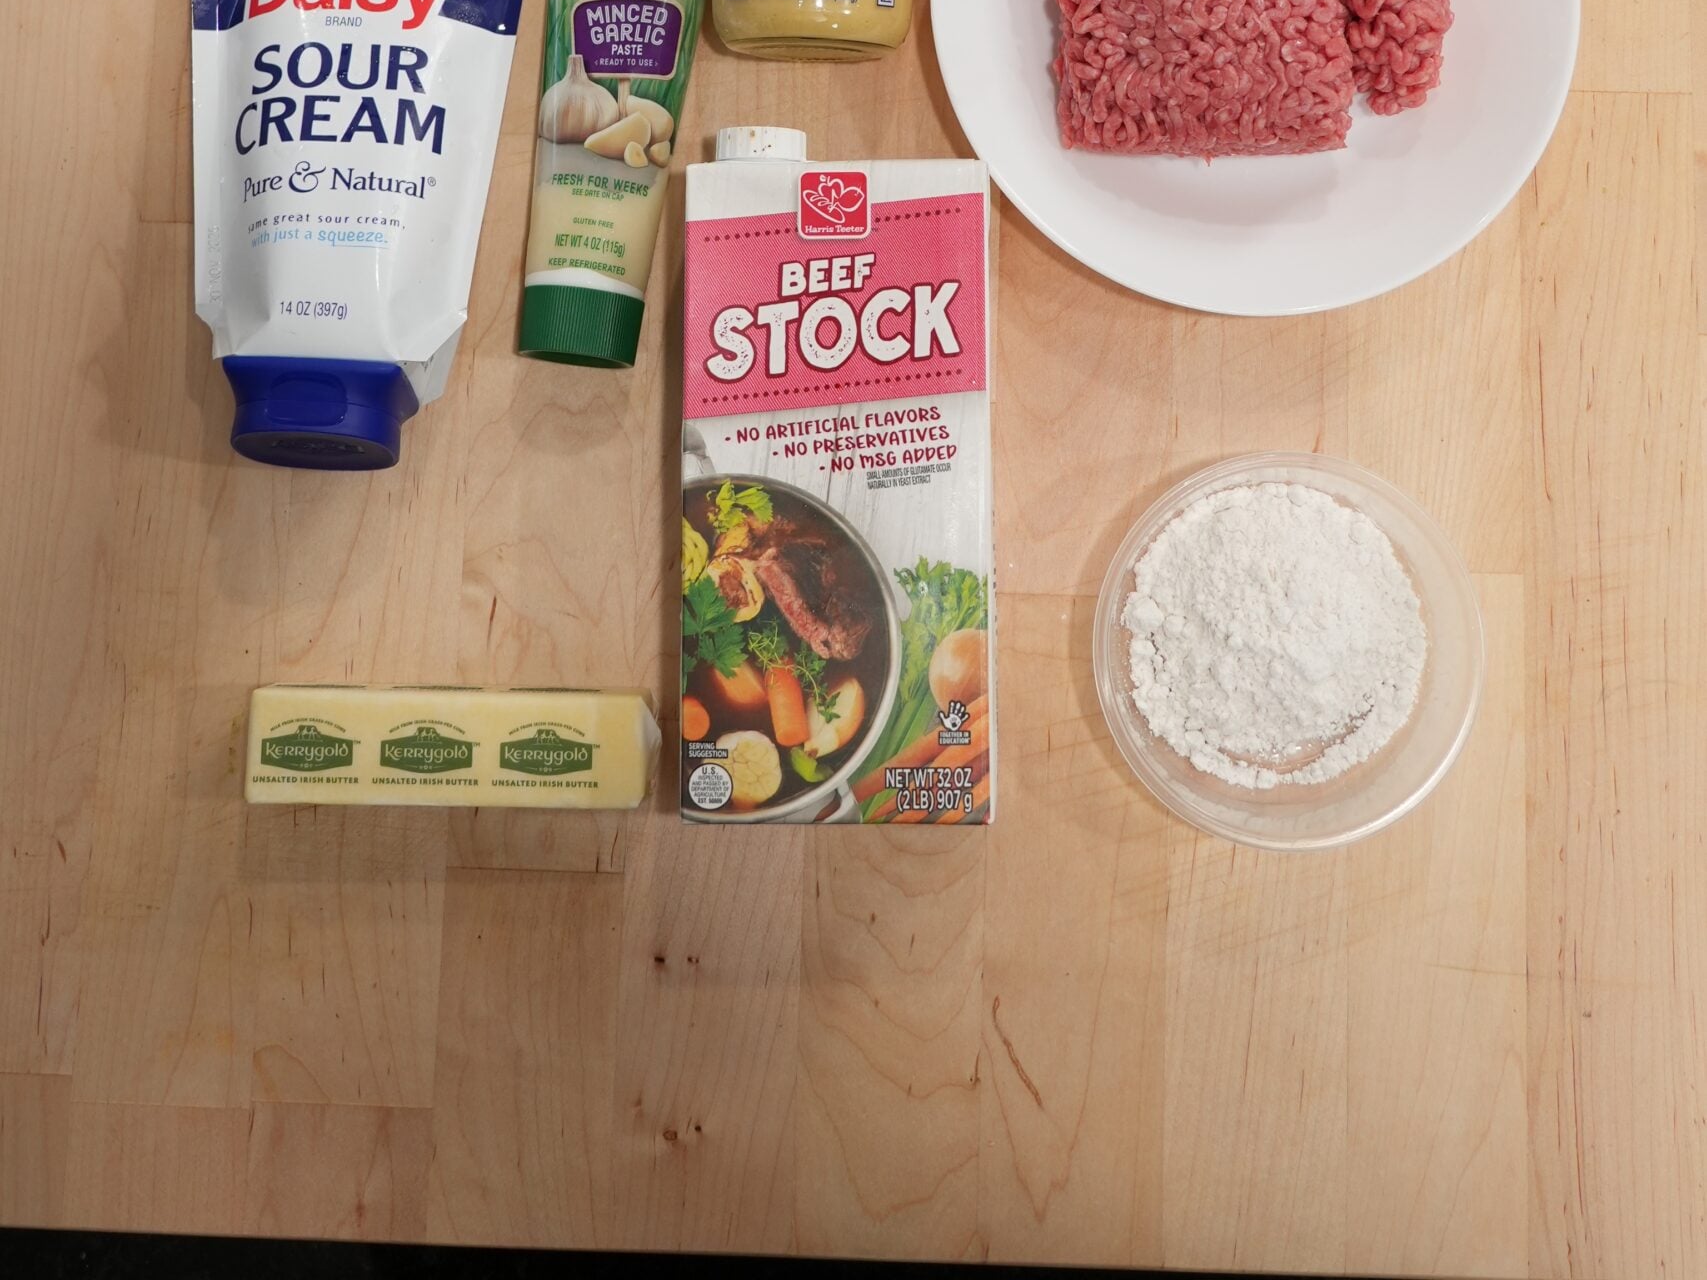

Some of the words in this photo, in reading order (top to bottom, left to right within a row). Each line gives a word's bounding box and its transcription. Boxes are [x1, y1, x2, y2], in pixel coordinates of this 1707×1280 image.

[325, 16, 362, 27] BRAND
[586, 3, 668, 26] MINCED
[590, 24, 666, 46] GARLIC
[611, 44, 643, 56] PASTE
[252, 42, 429, 95] SOUR
[600, 58, 624, 66] READY
[638, 59, 653, 67] USE
[235, 95, 446, 155] CREAM
[243, 175, 282, 203] Pure
[288, 160, 326, 193] &
[551, 173, 584, 185] FRESH
[588, 175, 609, 189] FOR
[613, 178, 649, 197] WEEKS
[572, 188, 583, 196] SEE
[585, 189, 600, 198] DATE
[602, 190, 610, 199] ON
[612, 192, 624, 201] CAP
[273, 213, 310, 226] great
[317, 214, 350, 224] sour
[572, 217, 596, 226] GLUTEN
[598, 219, 614, 228] FREE
[805, 225, 834, 233] Harris
[834, 224, 865, 233] Teeter
[251, 229, 270, 248] with
[273, 228, 299, 243] just
[304, 230, 313, 240] a
[317, 229, 388, 247] squeeze.
[555, 233, 569, 247] NET
[570, 234, 583, 248] WT
[583, 236, 589, 247] 4
[590, 236, 601, 250] OZ
[548, 257, 567, 266] KEEP
[569, 258, 626, 276] REFRIGERATED
[780, 253, 876, 297] BEEF
[280, 301, 293, 315] 14
[296, 300, 311, 316] OZ
[313, 301, 348, 320] (397g)
[706, 282, 961, 381] STOCK
[736, 426, 760, 444] NO
[766, 415, 860, 440] ARTIFICIAL
[865, 406, 941, 429] FLAVORS
[784, 440, 808, 458] NO
[813, 425, 950, 454] PRESERVATIVES
[831, 455, 854, 473] NO
[902, 444, 957, 465] ADDED
[866, 470, 881, 480] SMALL
[882, 467, 904, 478] AMOUNTS
[904, 467, 910, 476] OF
[910, 464, 935, 475] GLUTAMATE
[936, 463, 952, 472] OCCUR
[867, 479, 892, 490] NATURALLY
[898, 476, 911, 486] YEAST
[911, 475, 931, 485] EXTRACT
[688, 742, 715, 750] SERVING
[688, 750, 728, 758] SUGGESTION
[702, 766, 718, 775] U.S.
[886, 767, 911, 788] NET
[913, 767, 935, 788] WT
[936, 767, 951, 788] 32
[953, 767, 972, 788] OZ
[326, 776, 359, 784] BUTTER
[372, 777, 417, 785] UNSALTED
[445, 778, 479, 786] BUTTER
[491, 779, 537, 787] UNSALTED
[539, 780, 563, 788] IRISH
[565, 780, 599, 788] BUTTER
[896, 789, 910, 812] (2
[912, 789, 935, 812] LB)
[937, 789, 960, 809] 907
[964, 793, 972, 812] g
